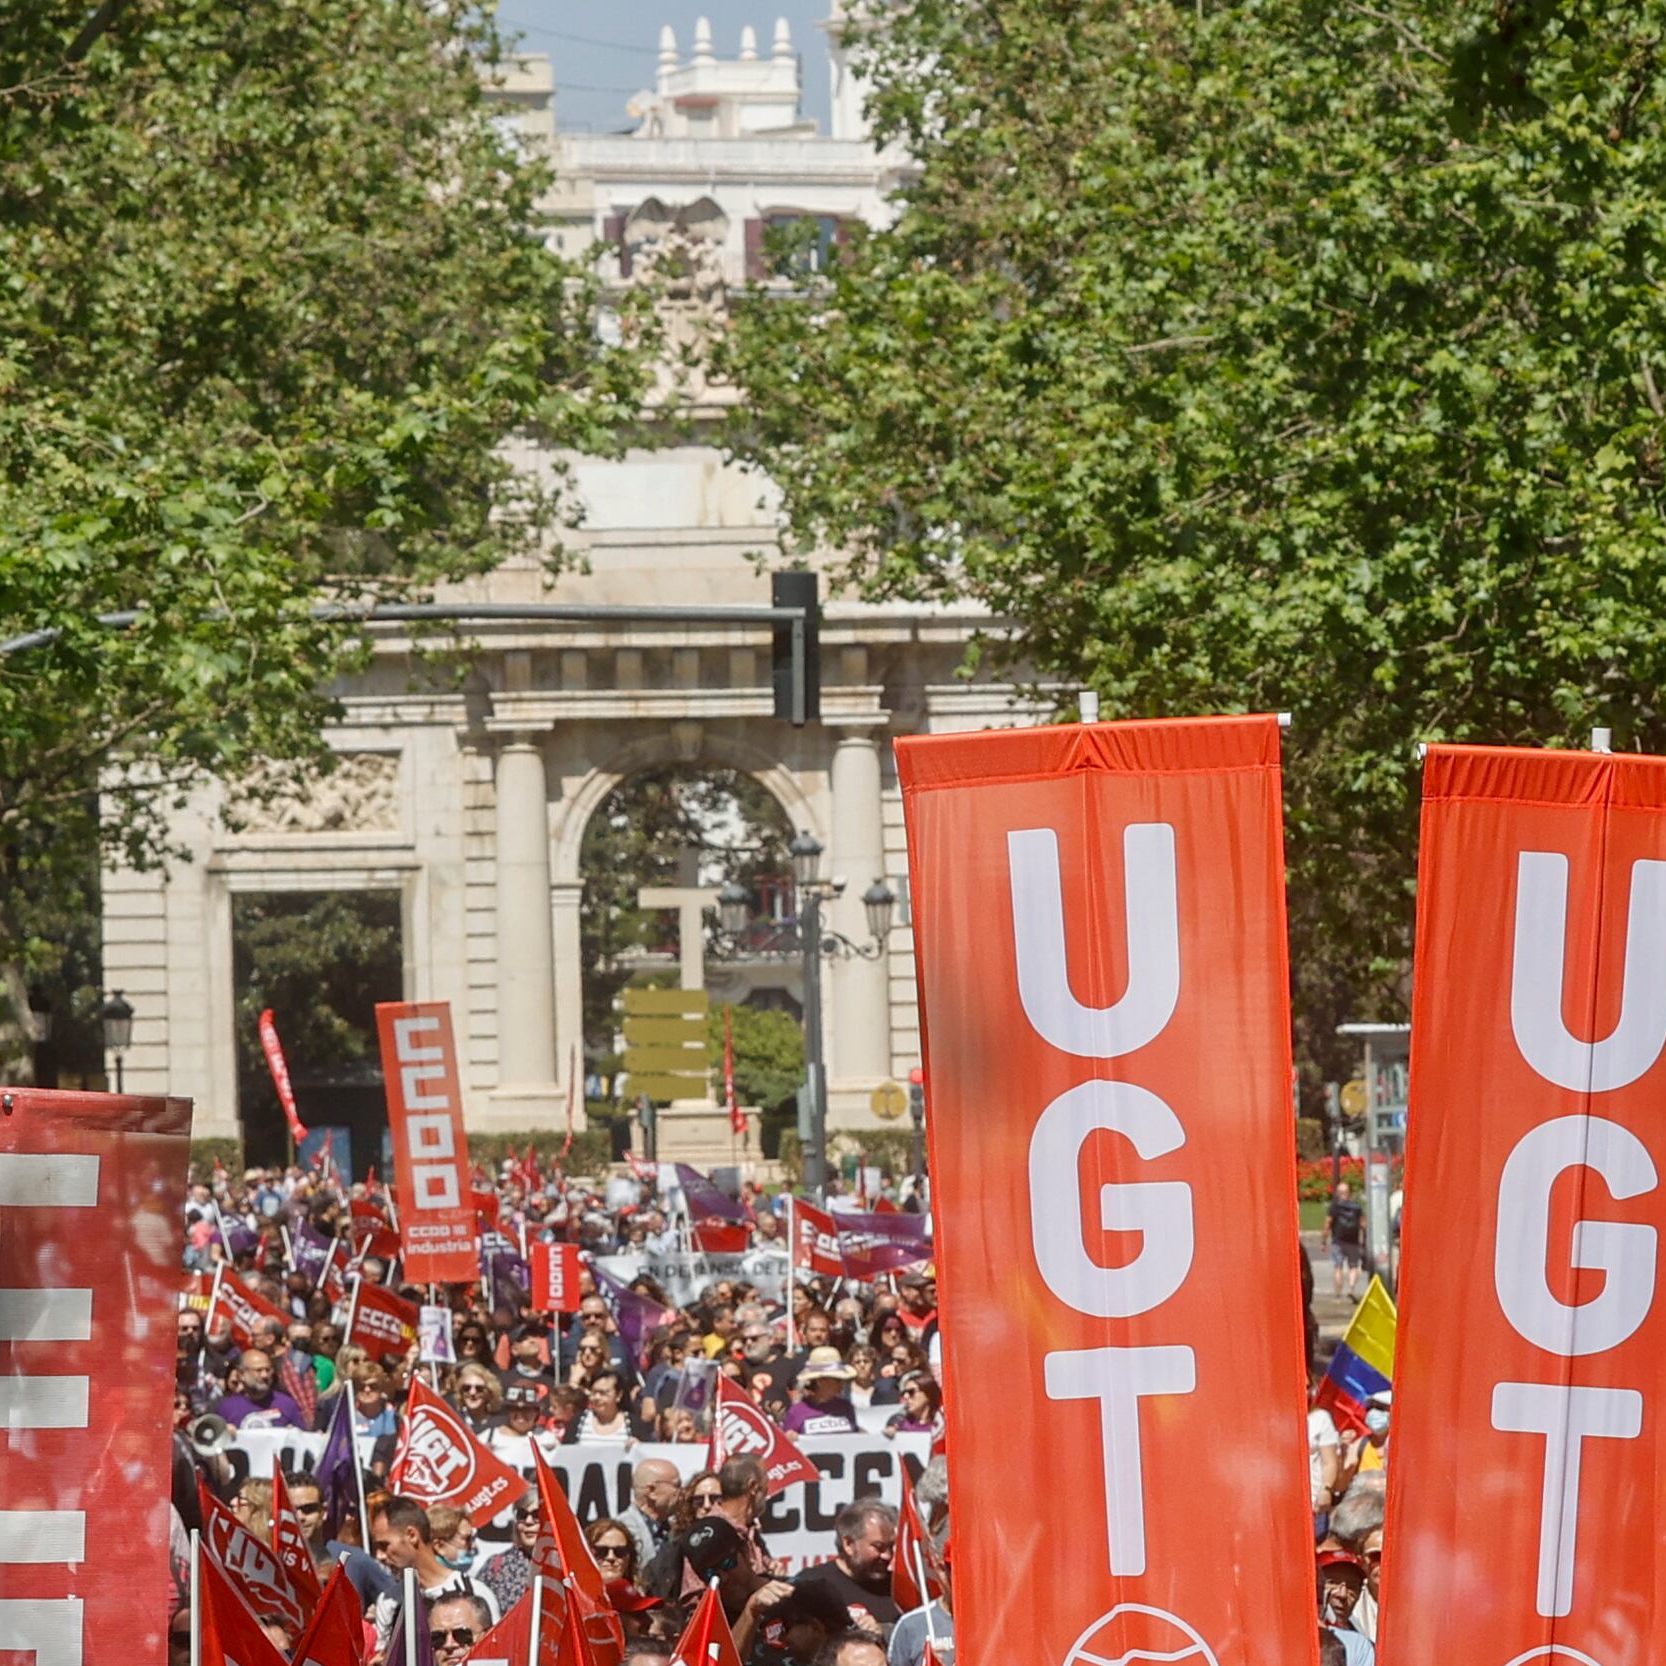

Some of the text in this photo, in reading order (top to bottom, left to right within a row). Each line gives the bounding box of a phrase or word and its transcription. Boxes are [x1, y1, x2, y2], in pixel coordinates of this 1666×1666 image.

[393, 1017, 460, 1209] CCOO
[1007, 822, 1196, 1576] UGT
[407, 1239, 472, 1255] industria
